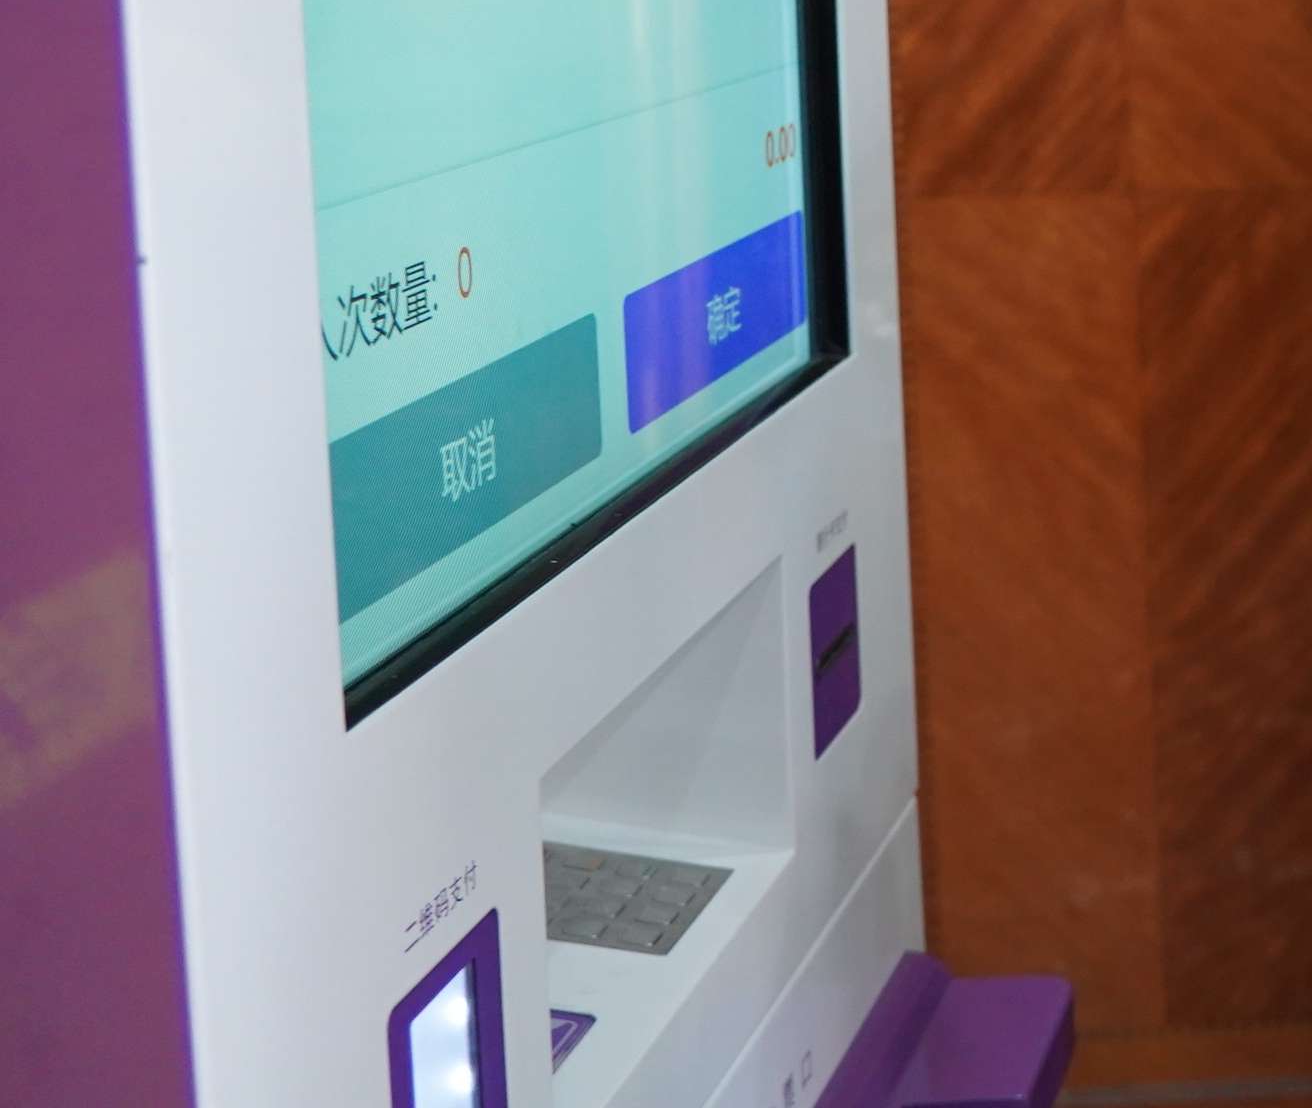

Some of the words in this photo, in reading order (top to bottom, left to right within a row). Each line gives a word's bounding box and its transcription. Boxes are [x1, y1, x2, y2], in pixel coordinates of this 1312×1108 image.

[457, 246, 473, 299] 0
[706, 286, 743, 346] 确定
[440, 418, 496, 503] 取消
[404, 859, 479, 954] 二维码支付
